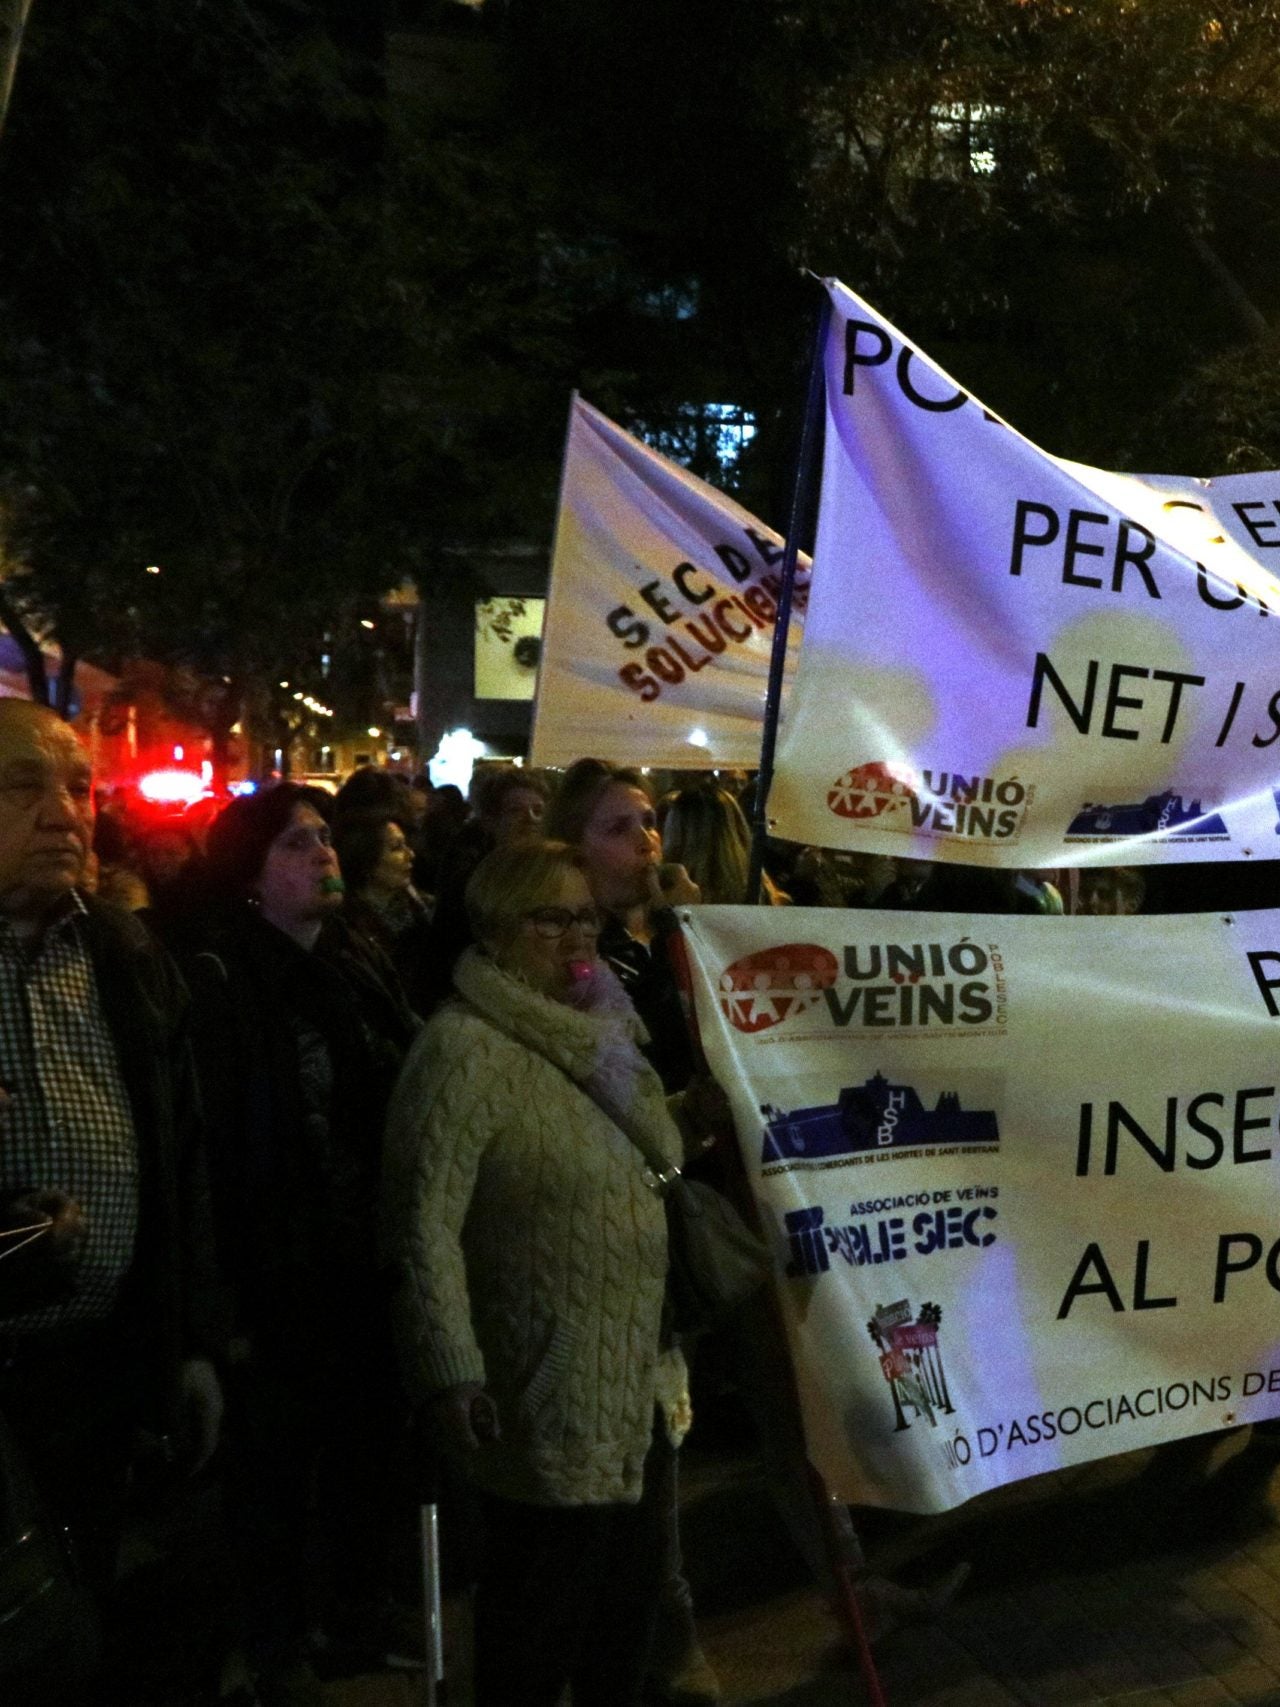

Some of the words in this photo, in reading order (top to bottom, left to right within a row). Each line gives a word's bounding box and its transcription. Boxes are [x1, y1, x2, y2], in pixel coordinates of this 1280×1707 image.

[1009, 499, 1162, 599] PER
[606, 562, 715, 650] SEC
[1026, 652, 1206, 744] NET
[1214, 681, 1246, 748] I
[921, 770, 1025, 807] UNIÓ
[843, 936, 988, 980] UNIÓ
[877, 1090, 905, 1146] HSB
[932, 1190, 952, 1204] DE
[913, 1206, 998, 1255] SEC
[1056, 1240, 1178, 1321] AL
